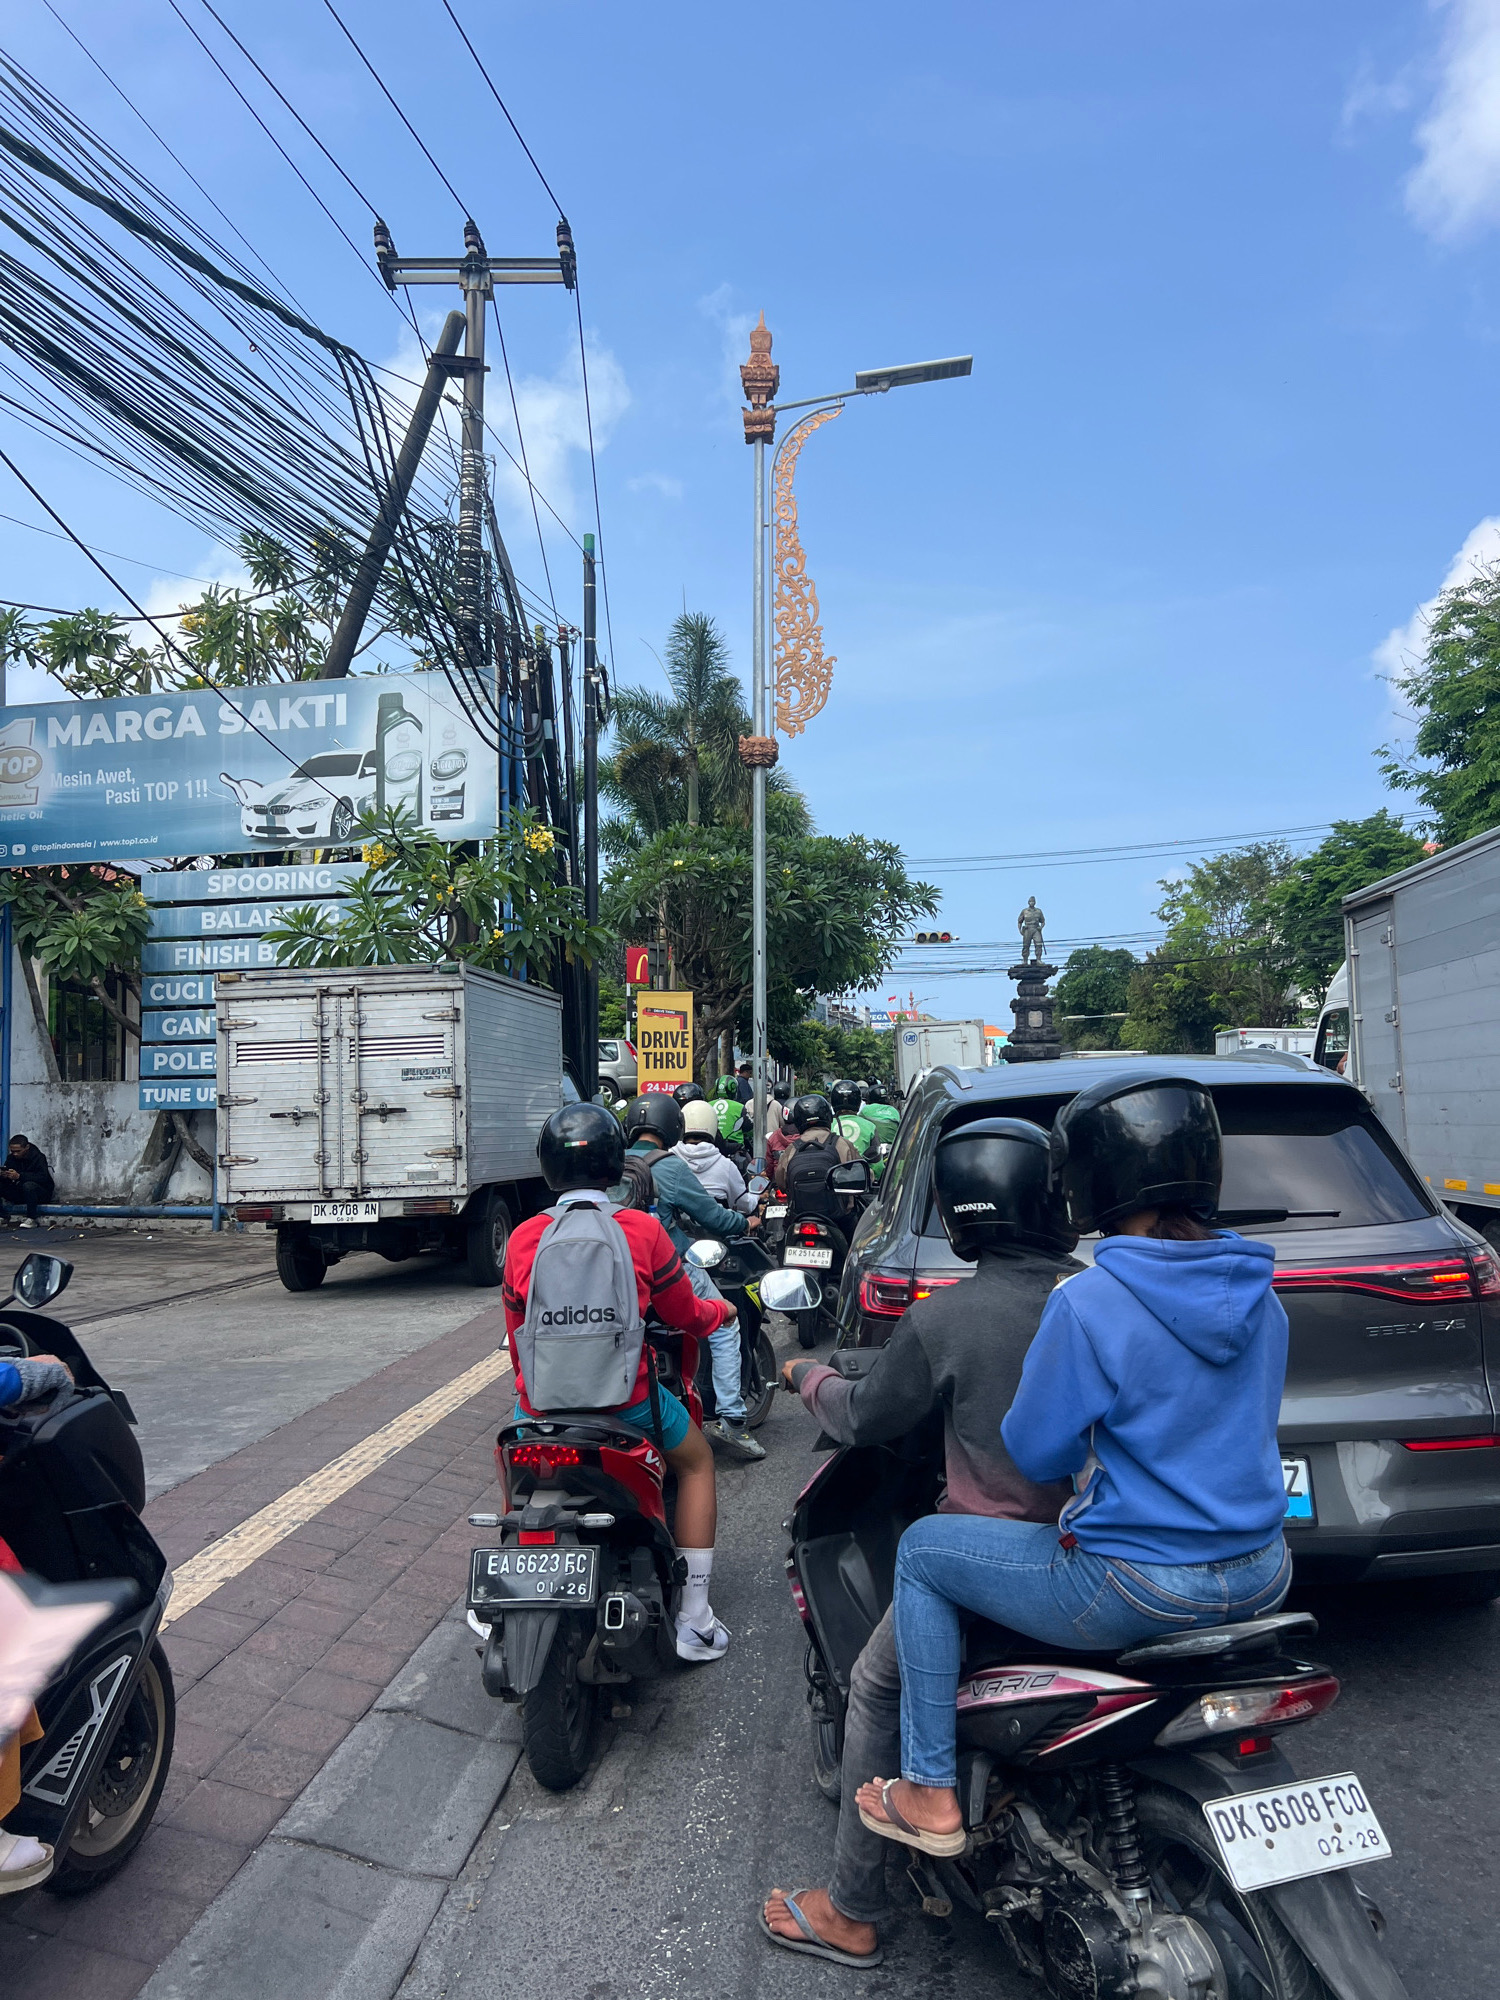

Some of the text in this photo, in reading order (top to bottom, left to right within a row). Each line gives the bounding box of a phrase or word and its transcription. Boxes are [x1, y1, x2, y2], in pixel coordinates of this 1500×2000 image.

[47, 693, 347, 748] MARGA SAKTI
[51, 768, 136, 788] Mesin Awet,
[106, 788, 140, 805] Pasti
[144, 782, 178, 801] TOP
[0, 810, 43, 821] hetic Oil
[100, 836, 158, 848] www.top1.co.id
[207, 871, 332, 893] SPOORING
[201, 905, 339, 930] BALANG
[174, 945, 249, 966] FINISH
[150, 982, 204, 1001] CUCI
[641, 1031, 689, 1049] DRIVE
[643, 1052, 687, 1069] THRU
[142, 1088, 191, 1103] TUNE
[646, 1083, 659, 1092] 24
[314, 1203, 377, 1216] DK 8708 AN
[953, 1202, 997, 1213] HONDA
[541, 1305, 616, 1325] adidas
[487, 1553, 587, 1575] EA 6623 FC
[971, 1672, 1058, 1699] VARIO
[1214, 1804, 1257, 1843] DK
[1256, 1791, 1321, 1833] 6608
